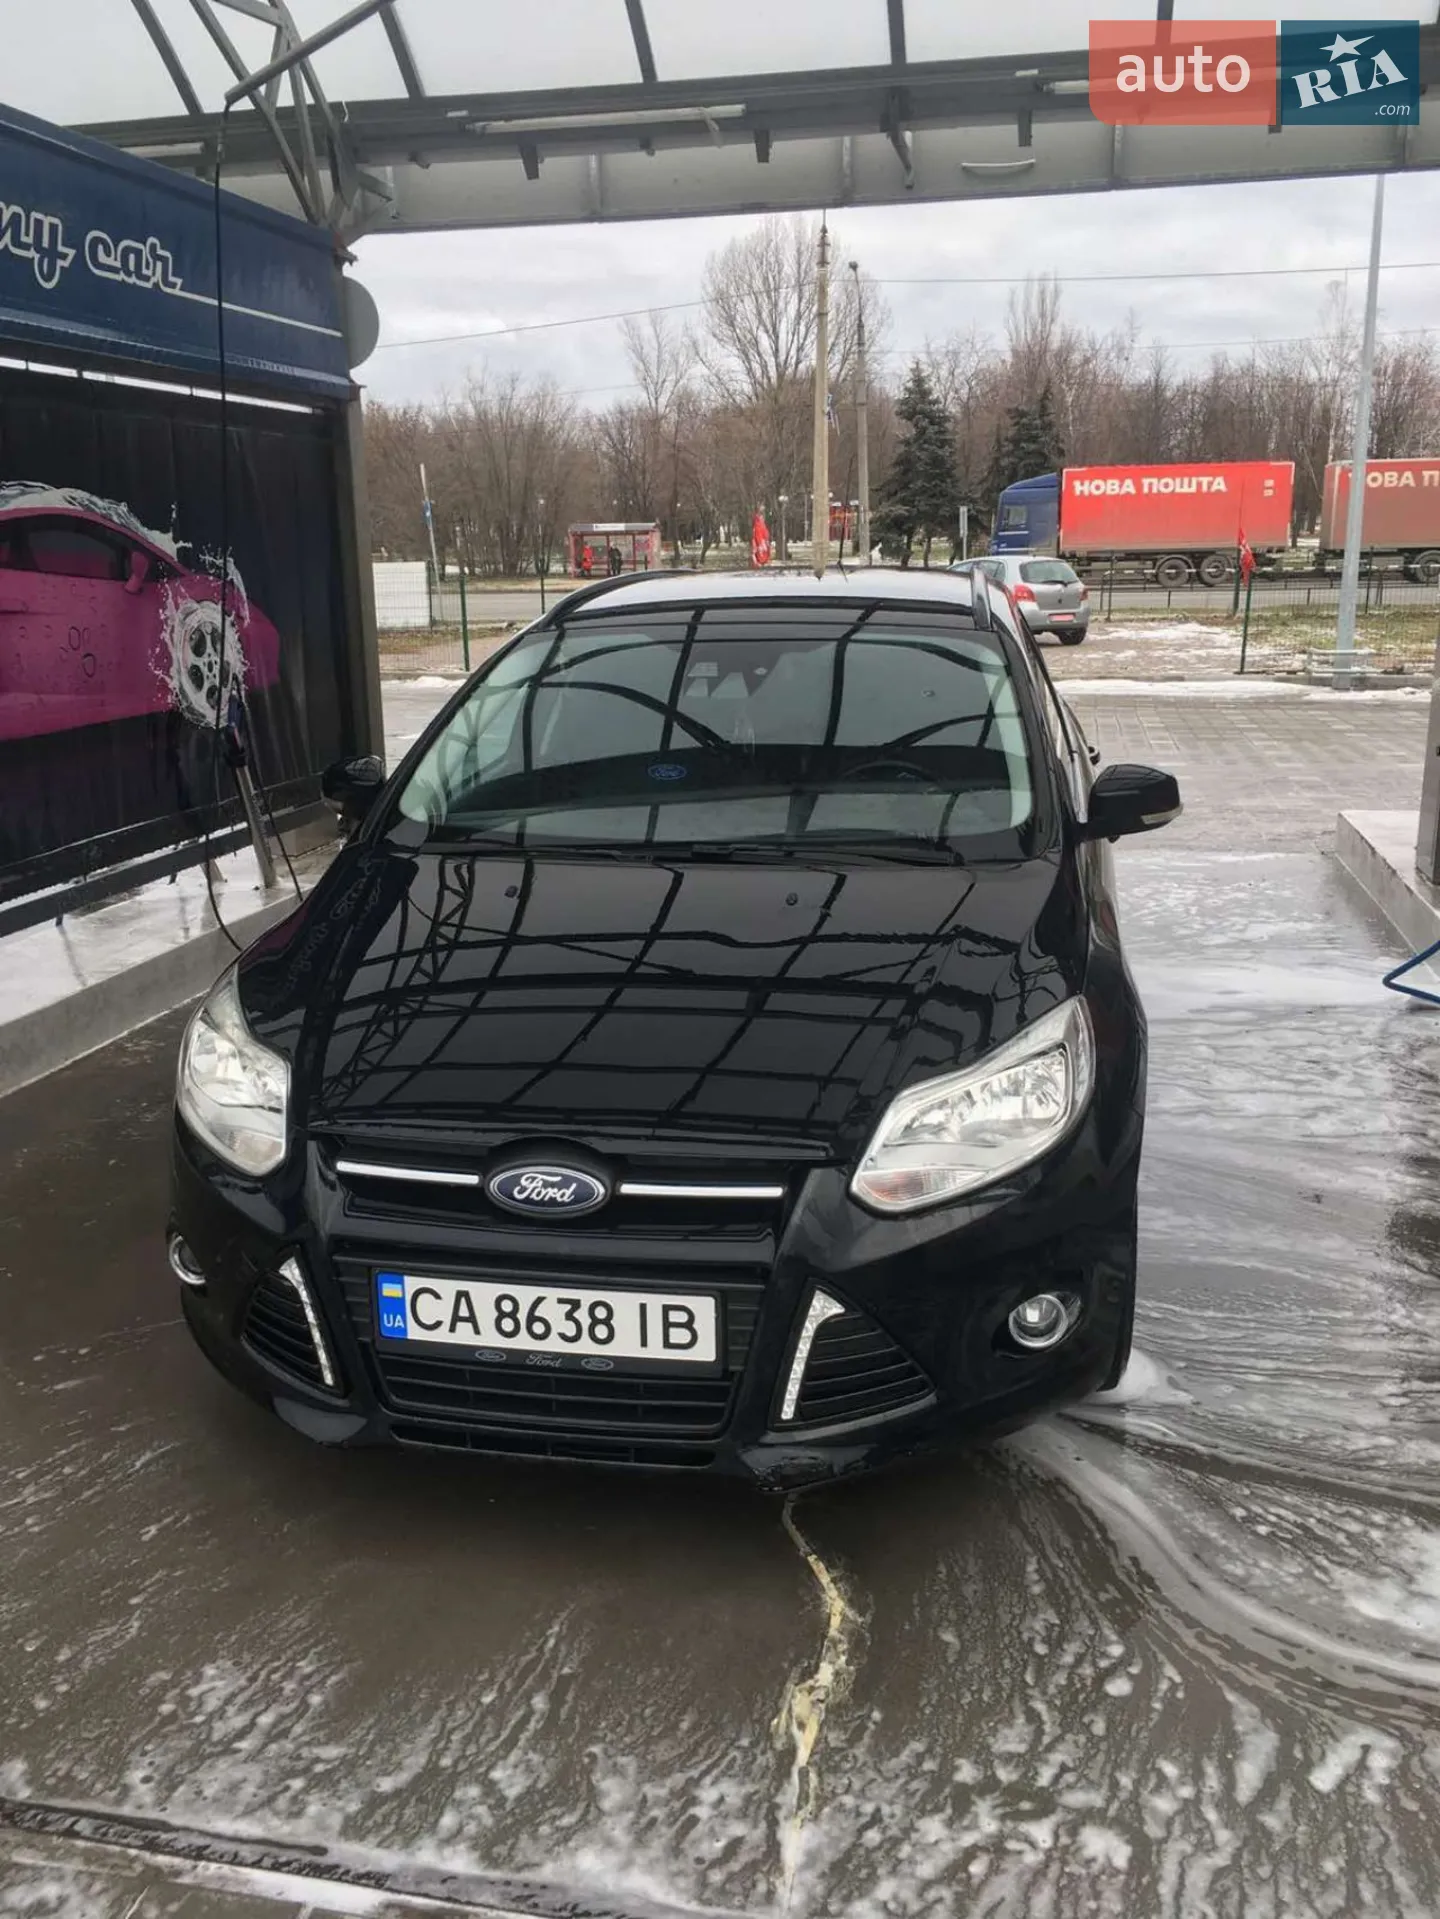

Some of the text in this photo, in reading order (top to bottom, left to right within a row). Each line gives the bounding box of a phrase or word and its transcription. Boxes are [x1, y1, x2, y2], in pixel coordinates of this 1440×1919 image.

[85, 230, 183, 291] car
[1073, 476, 1227, 496] НОВА ПОШТА
[1348, 470, 1416, 488] ОВА
[513, 1173, 576, 1202] Ford
[383, 1315, 405, 1328] UA
[410, 1286, 699, 1351] CA 8638 IB
[525, 1352, 563, 1368] Ford
